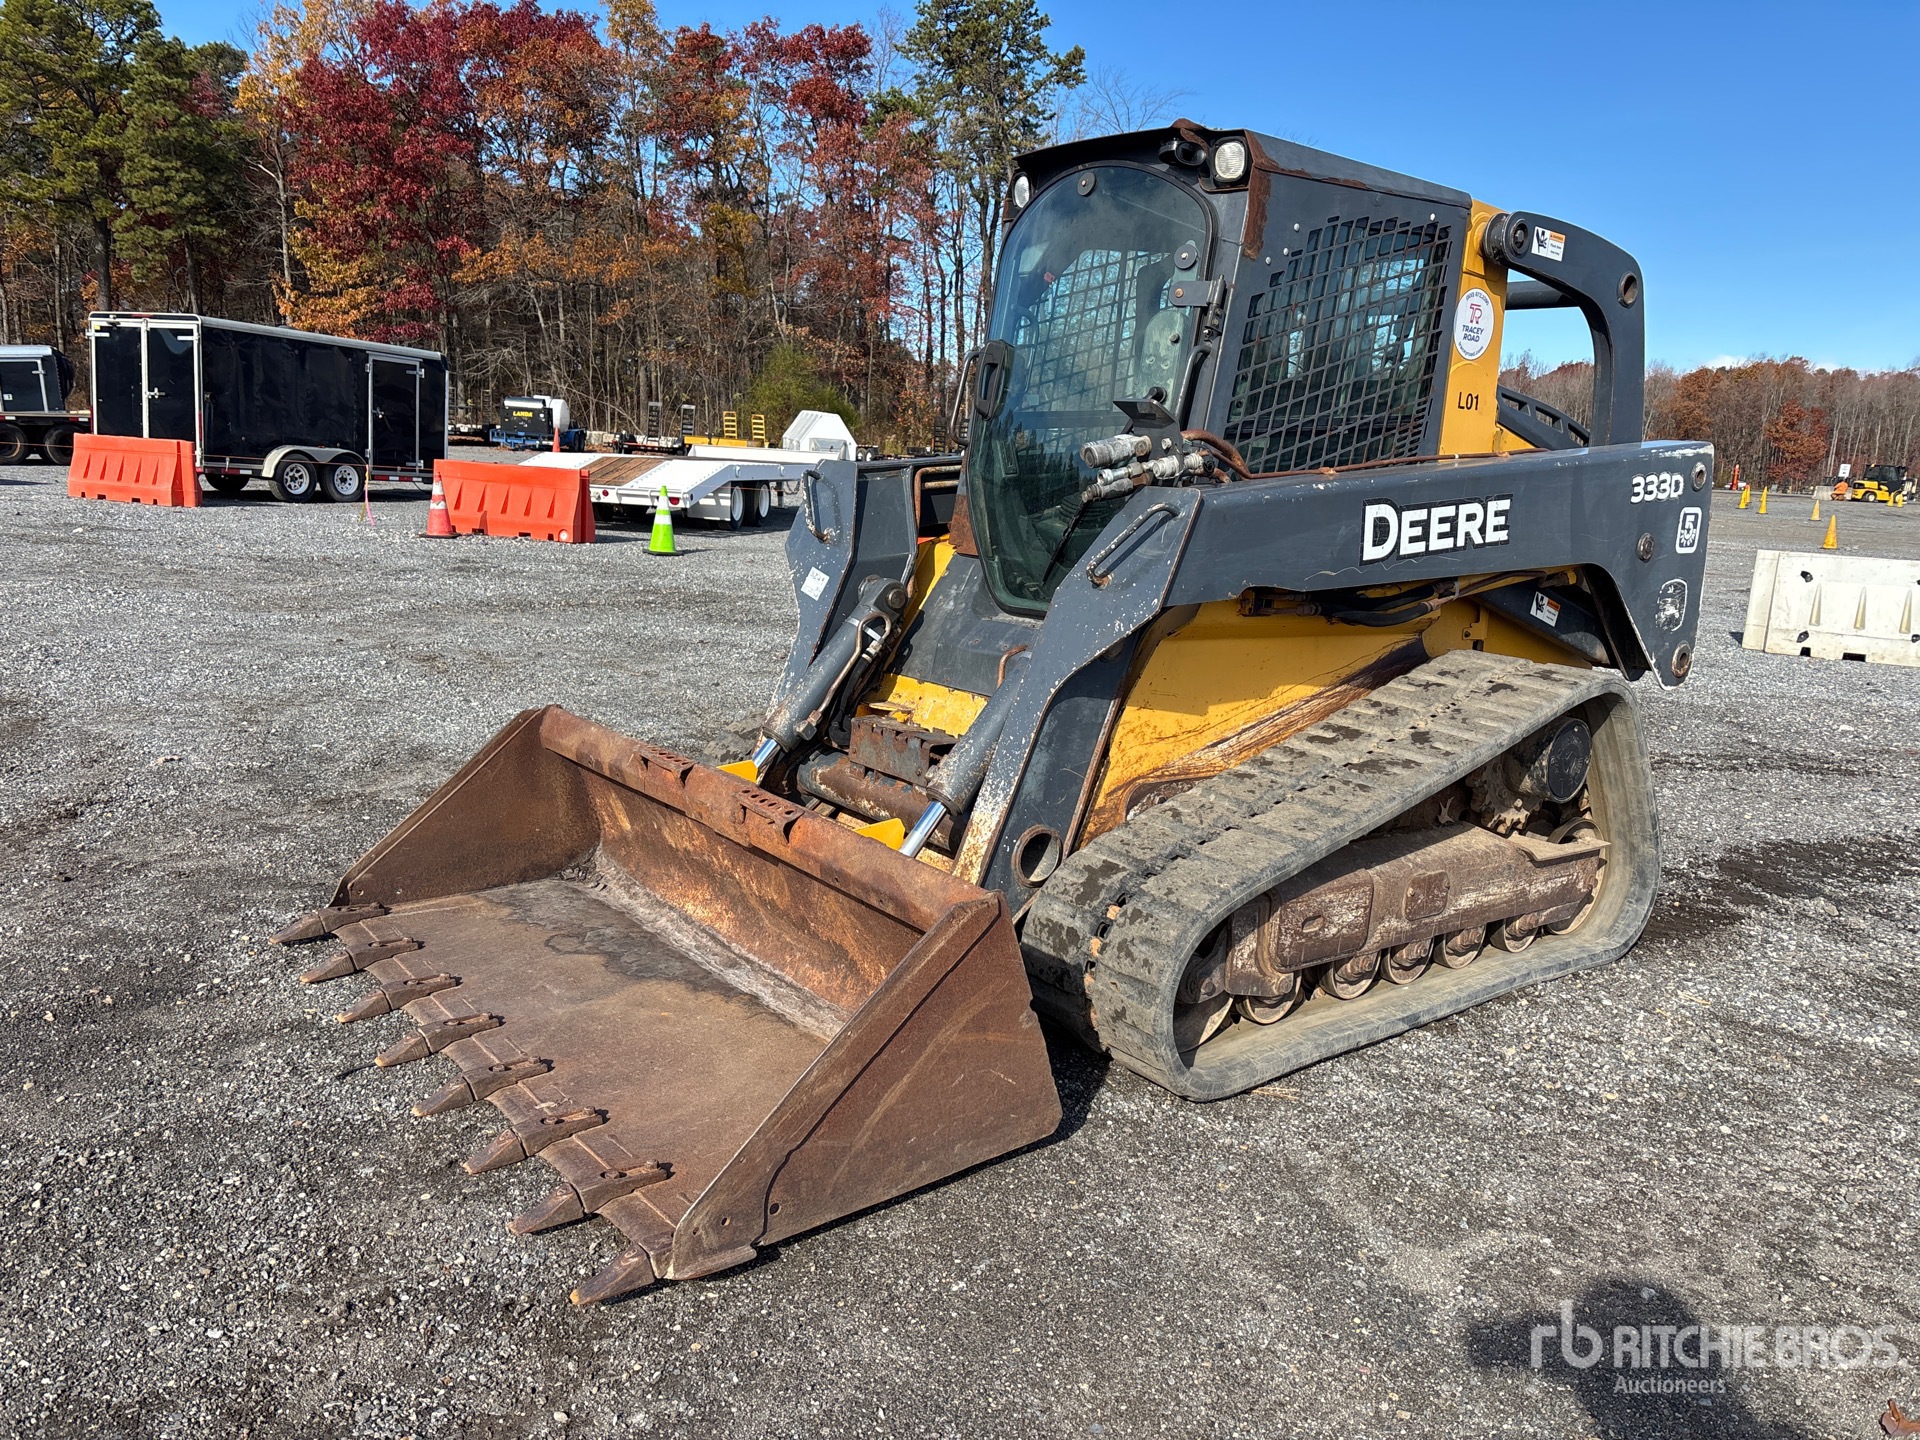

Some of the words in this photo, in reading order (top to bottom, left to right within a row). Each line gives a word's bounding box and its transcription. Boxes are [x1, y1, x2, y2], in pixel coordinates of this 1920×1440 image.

[1462, 325, 1484, 335] TRACEY
[1463, 333, 1480, 342] ROAD
[1457, 391, 1479, 411] L01
[1630, 472, 1685, 503] 333D
[1362, 498, 1512, 562] DEERE
